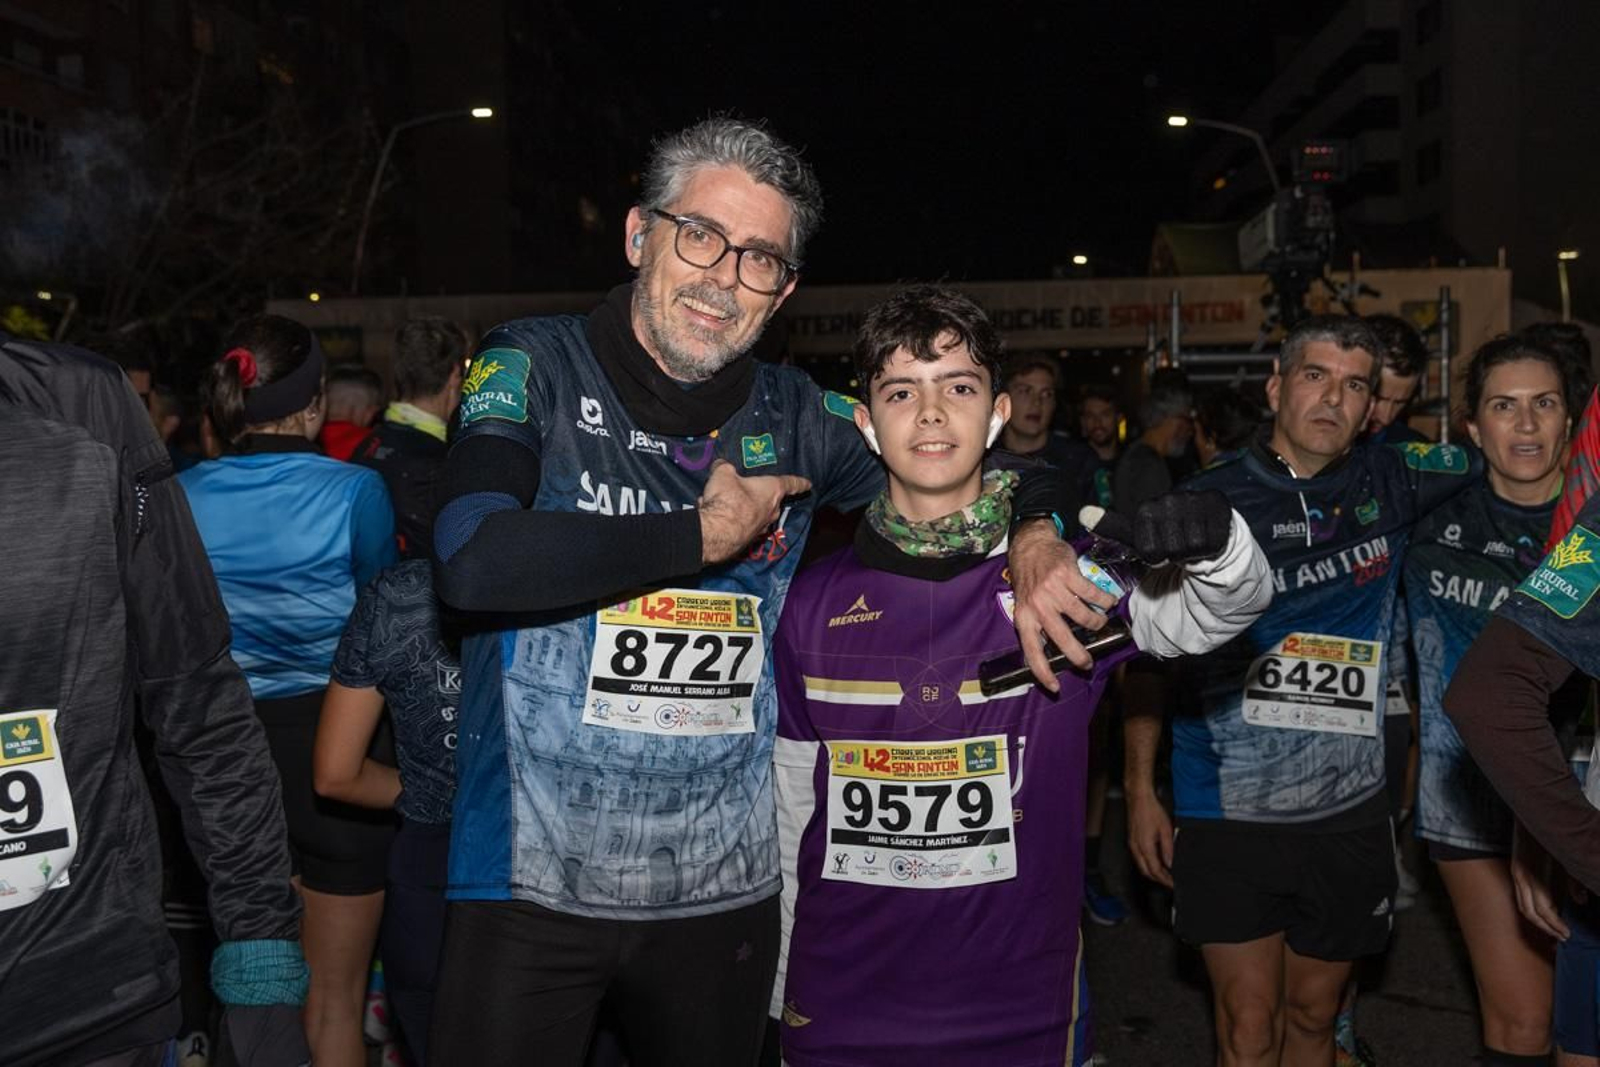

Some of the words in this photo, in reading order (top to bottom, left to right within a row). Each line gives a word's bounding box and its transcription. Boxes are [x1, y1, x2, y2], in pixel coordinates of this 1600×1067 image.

[1071, 306, 1103, 328] DE
[577, 470, 646, 516] SAN
[1297, 536, 1389, 588] ANTON
[1429, 570, 1483, 607] SAN
[1540, 568, 1579, 600] RURAL
[641, 596, 676, 622] 42
[676, 610, 697, 621] SAN
[700, 612, 731, 623] ANTON
[828, 610, 884, 628] MERCURY
[610, 629, 753, 682] 8727
[629, 683, 648, 692] JOSÉ
[650, 685, 682, 694] MANUEL
[684, 686, 715, 696] SERRANO
[1258, 657, 1366, 698] 6420
[864, 748, 892, 773] 42
[892, 762, 914, 773] SAN
[917, 760, 959, 772] ANTON
[843, 781, 993, 832] 9579
[868, 835, 889, 844] JAIME
[890, 835, 924, 846] SÁNCHEZ
[926, 834, 969, 847] MARTÍNEZ
